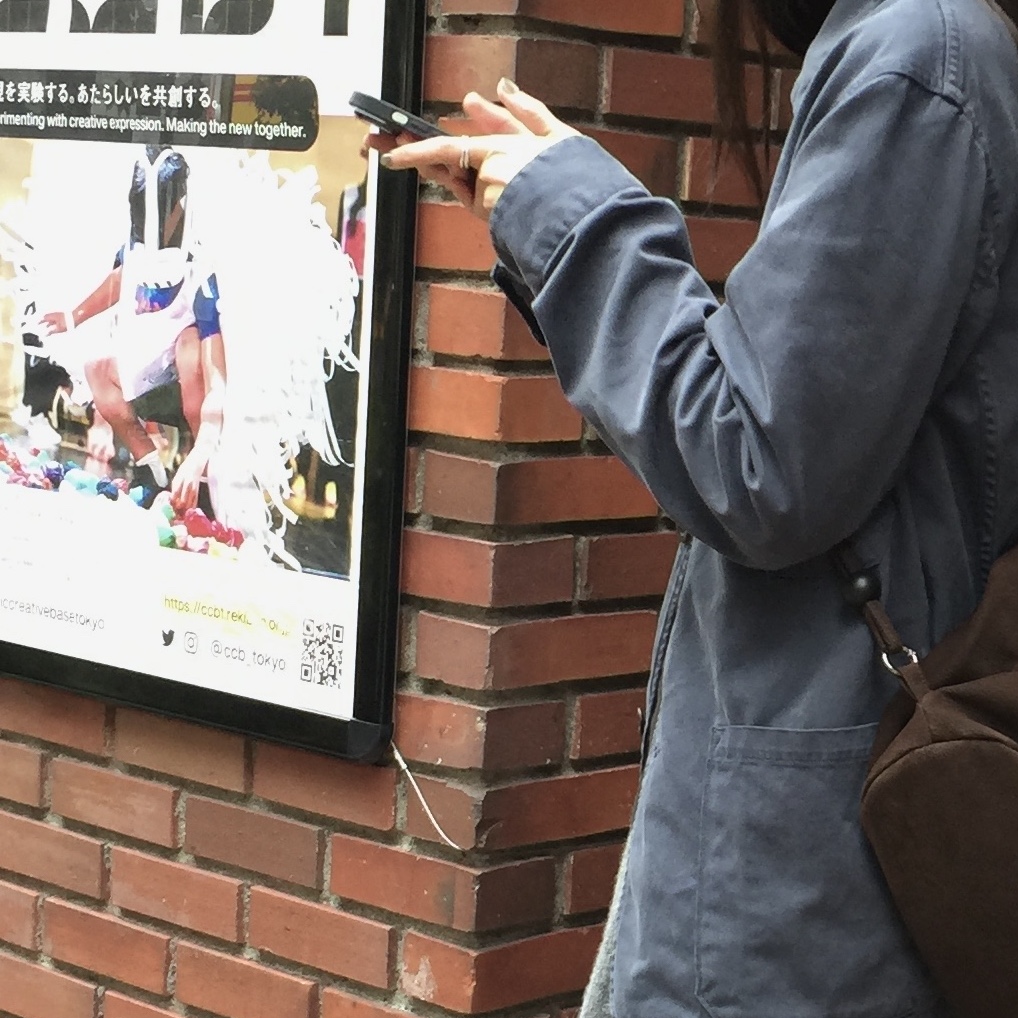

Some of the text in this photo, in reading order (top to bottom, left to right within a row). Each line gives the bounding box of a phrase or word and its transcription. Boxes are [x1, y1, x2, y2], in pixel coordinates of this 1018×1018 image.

[47, 113, 67, 127] with
[69, 115, 108, 129] creative
[109, 117, 164, 133] expression.
[166, 117, 207, 137] Making
[209, 119, 227, 134] the
[229, 123, 252, 135] new
[254, 122, 307, 140] together.
